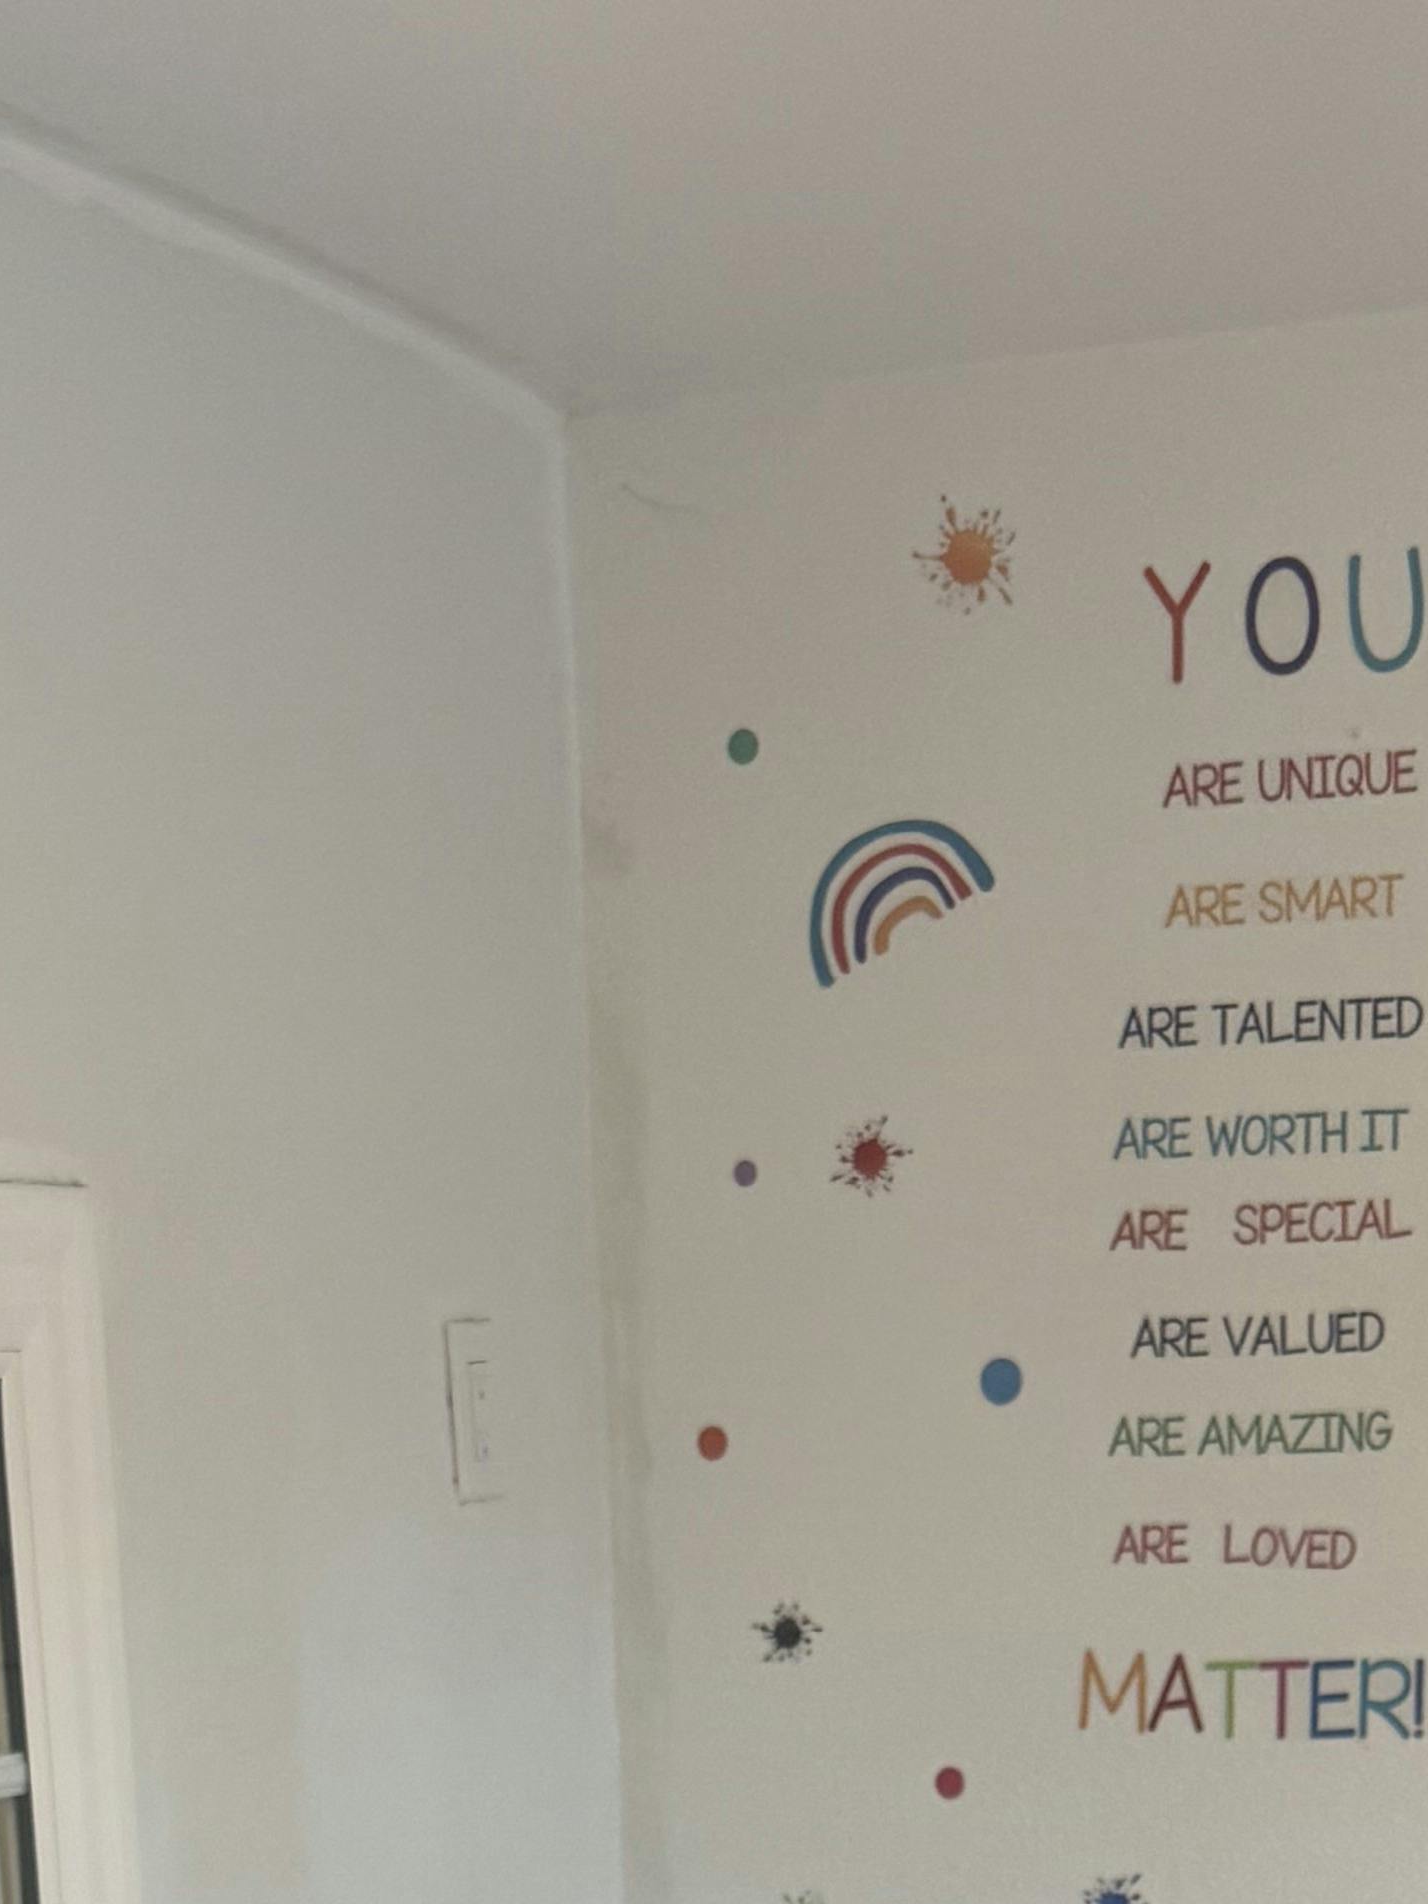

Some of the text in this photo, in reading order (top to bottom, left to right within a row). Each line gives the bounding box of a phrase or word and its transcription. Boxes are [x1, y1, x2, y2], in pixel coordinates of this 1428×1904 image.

[1143, 545, 1425, 685] YOU
[1162, 748, 1419, 808] ARE UNIQUE
[1164, 873, 1404, 928] ARE SMART
[1117, 996, 1424, 1048] ARE TALENTED
[1112, 1108, 1410, 1160] ARE WORTH IT
[1108, 1198, 1413, 1251] ARE SPECIAL
[1130, 1311, 1386, 1359] ARE VALUED
[1107, 1411, 1394, 1458] ARE AMAZING
[1112, 1523, 1358, 1571] ARE LOVED
[1077, 1648, 1425, 1740] MATTER!
